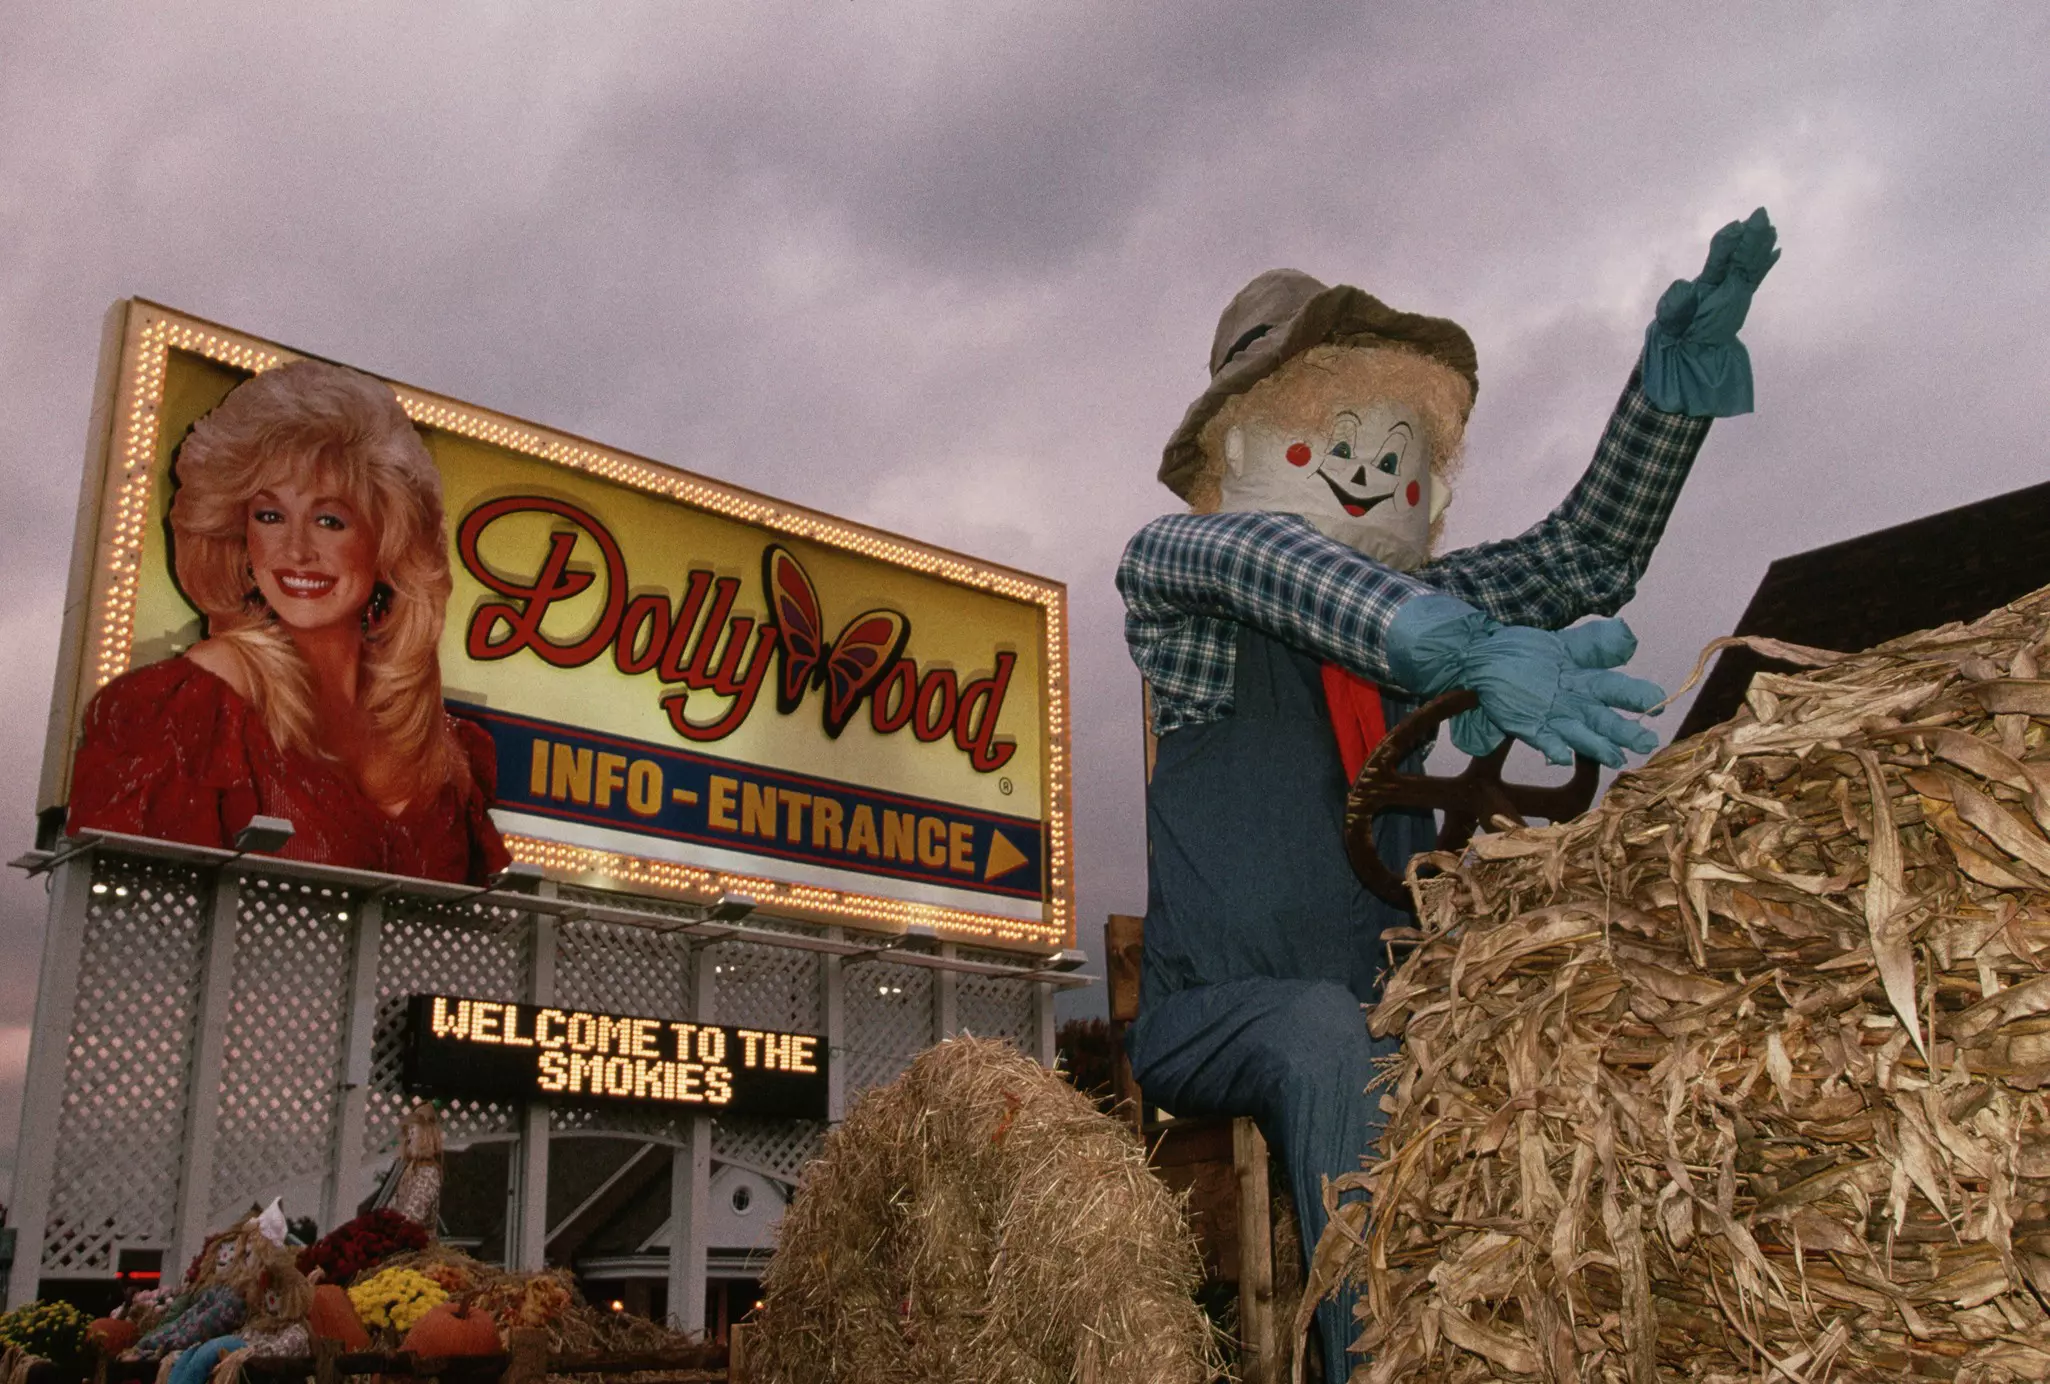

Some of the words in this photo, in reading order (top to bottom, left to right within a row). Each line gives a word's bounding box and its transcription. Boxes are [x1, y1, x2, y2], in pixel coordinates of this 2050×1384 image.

[431, 996, 661, 1059] WELCOME
[671, 1023, 726, 1064] TO
[737, 1029, 818, 1074] THE
[537, 1051, 733, 1104] SMOKIES
